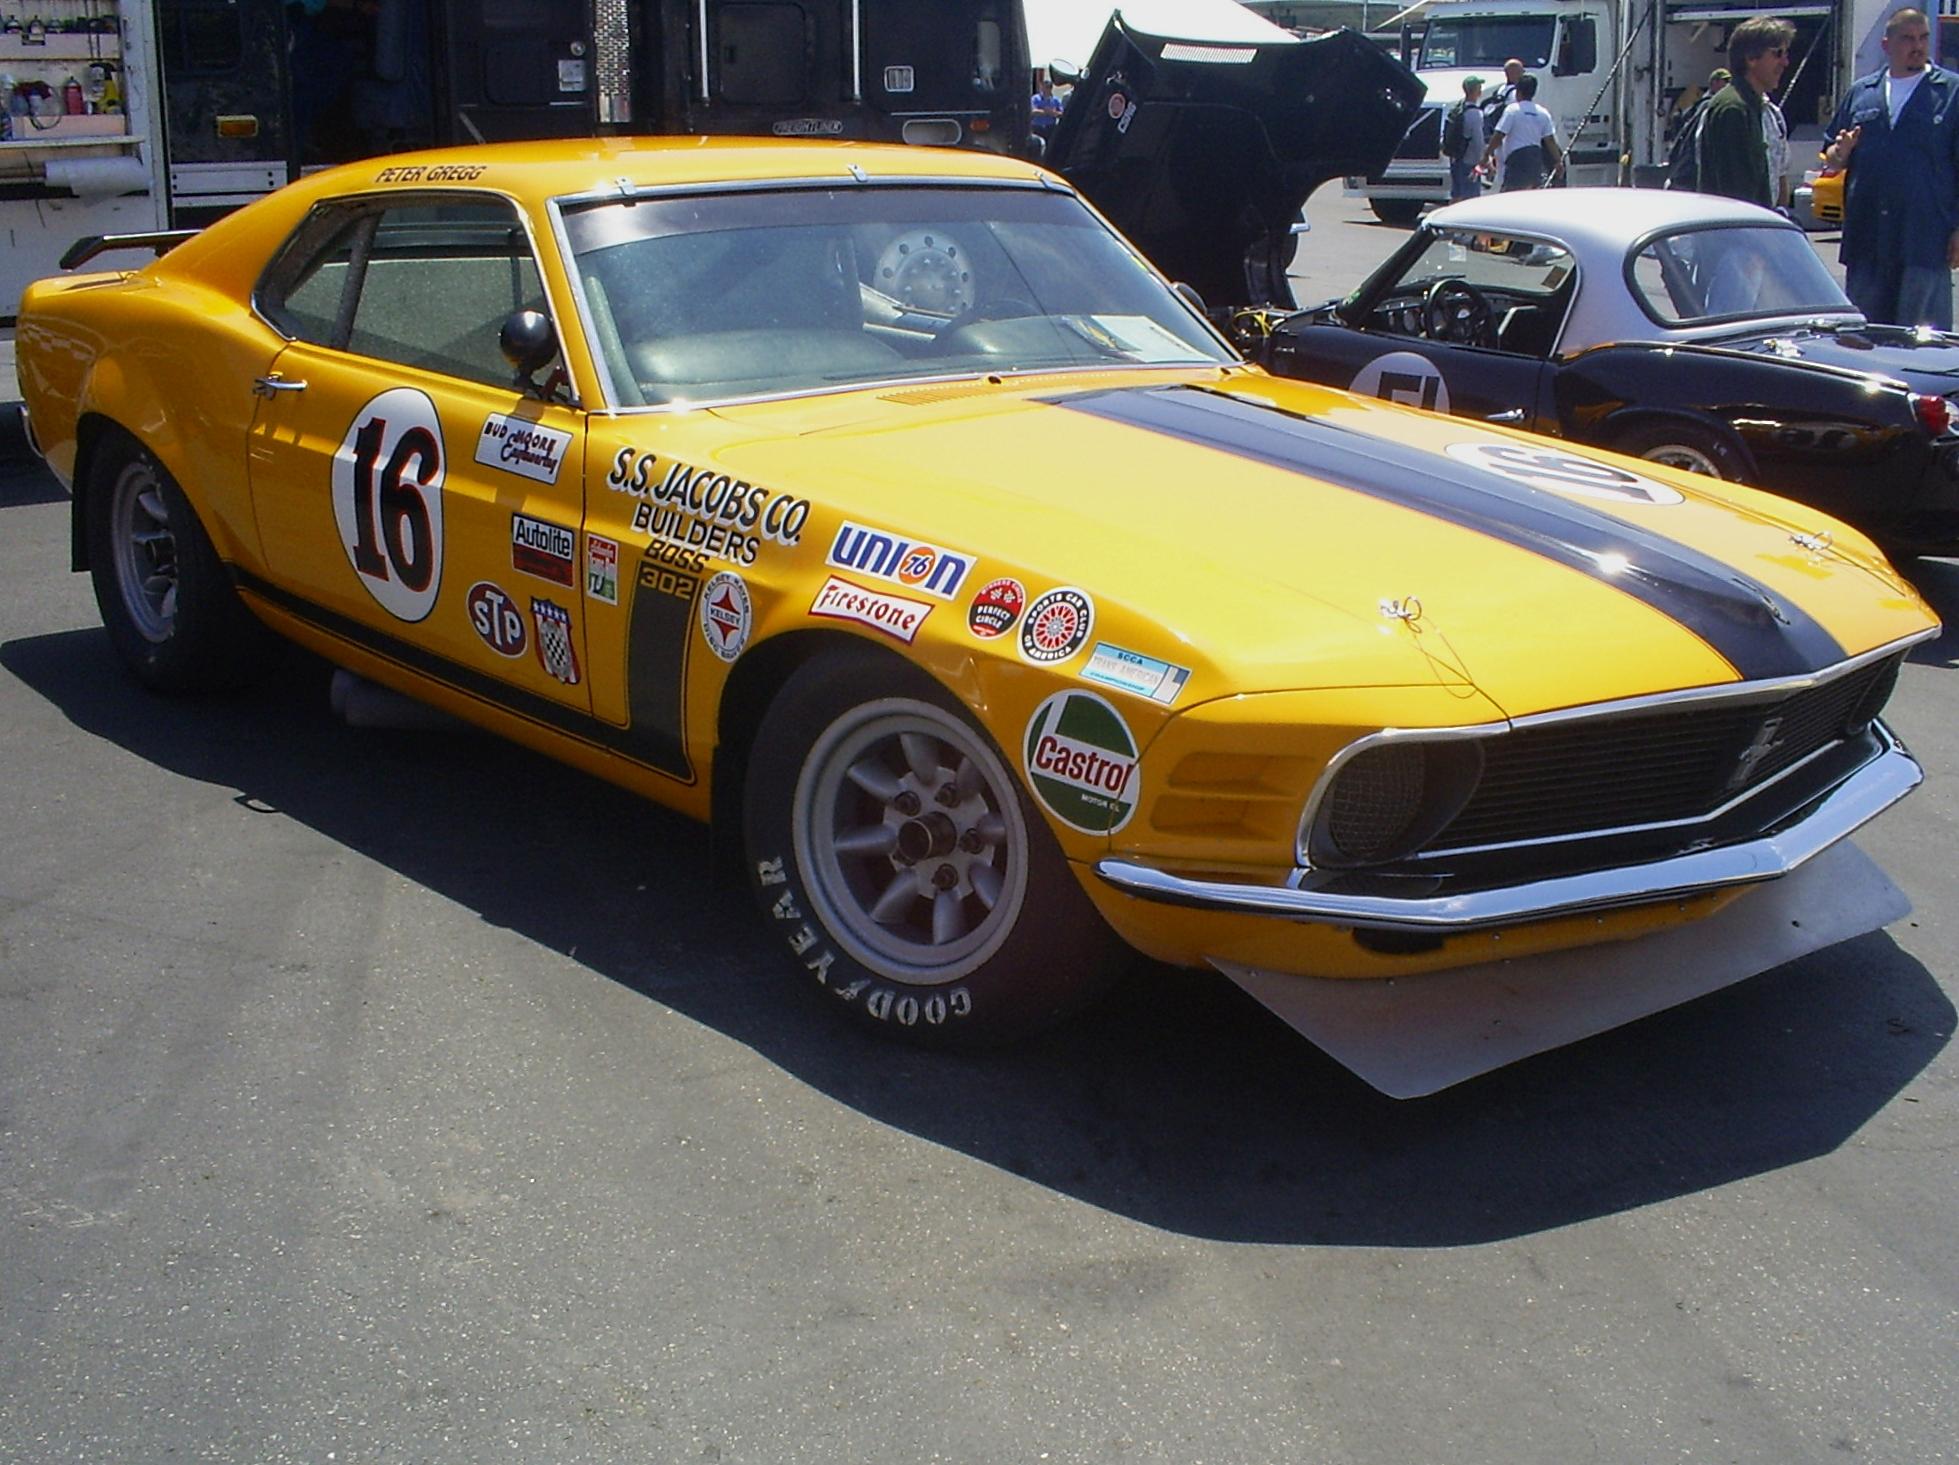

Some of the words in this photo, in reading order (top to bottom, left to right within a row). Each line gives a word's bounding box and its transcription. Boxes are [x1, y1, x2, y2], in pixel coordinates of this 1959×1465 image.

[375, 165, 427, 183] PETER
[426, 165, 487, 181] GREGG
[484, 422, 508, 439] BUD
[353, 417, 440, 592] 16
[607, 447, 657, 498] S.S.
[651, 463, 769, 531] JACOBS
[762, 494, 811, 546] CO.
[515, 519, 570, 557] Autolite
[631, 503, 761, 567] BUILDERS
[644, 539, 711, 573] BOSS
[904, 556, 929, 575] 76
[641, 567, 694, 600] 302
[474, 590, 520, 646] STP
[710, 607, 741, 626] KELSEY
[819, 584, 915, 630] Firestone
[975, 614, 1003, 629] CIRCLE
[977, 605, 1010, 620] PERFECT
[1027, 593, 1063, 624] SPORTS
[1065, 593, 1083, 607] CAR
[1076, 609, 1088, 637] CLUB
[1024, 635, 1033, 646] OF
[1029, 646, 1071, 659] AMERICA
[1118, 652, 1143, 665] SCCA
[1036, 736, 1134, 794] Castrol
